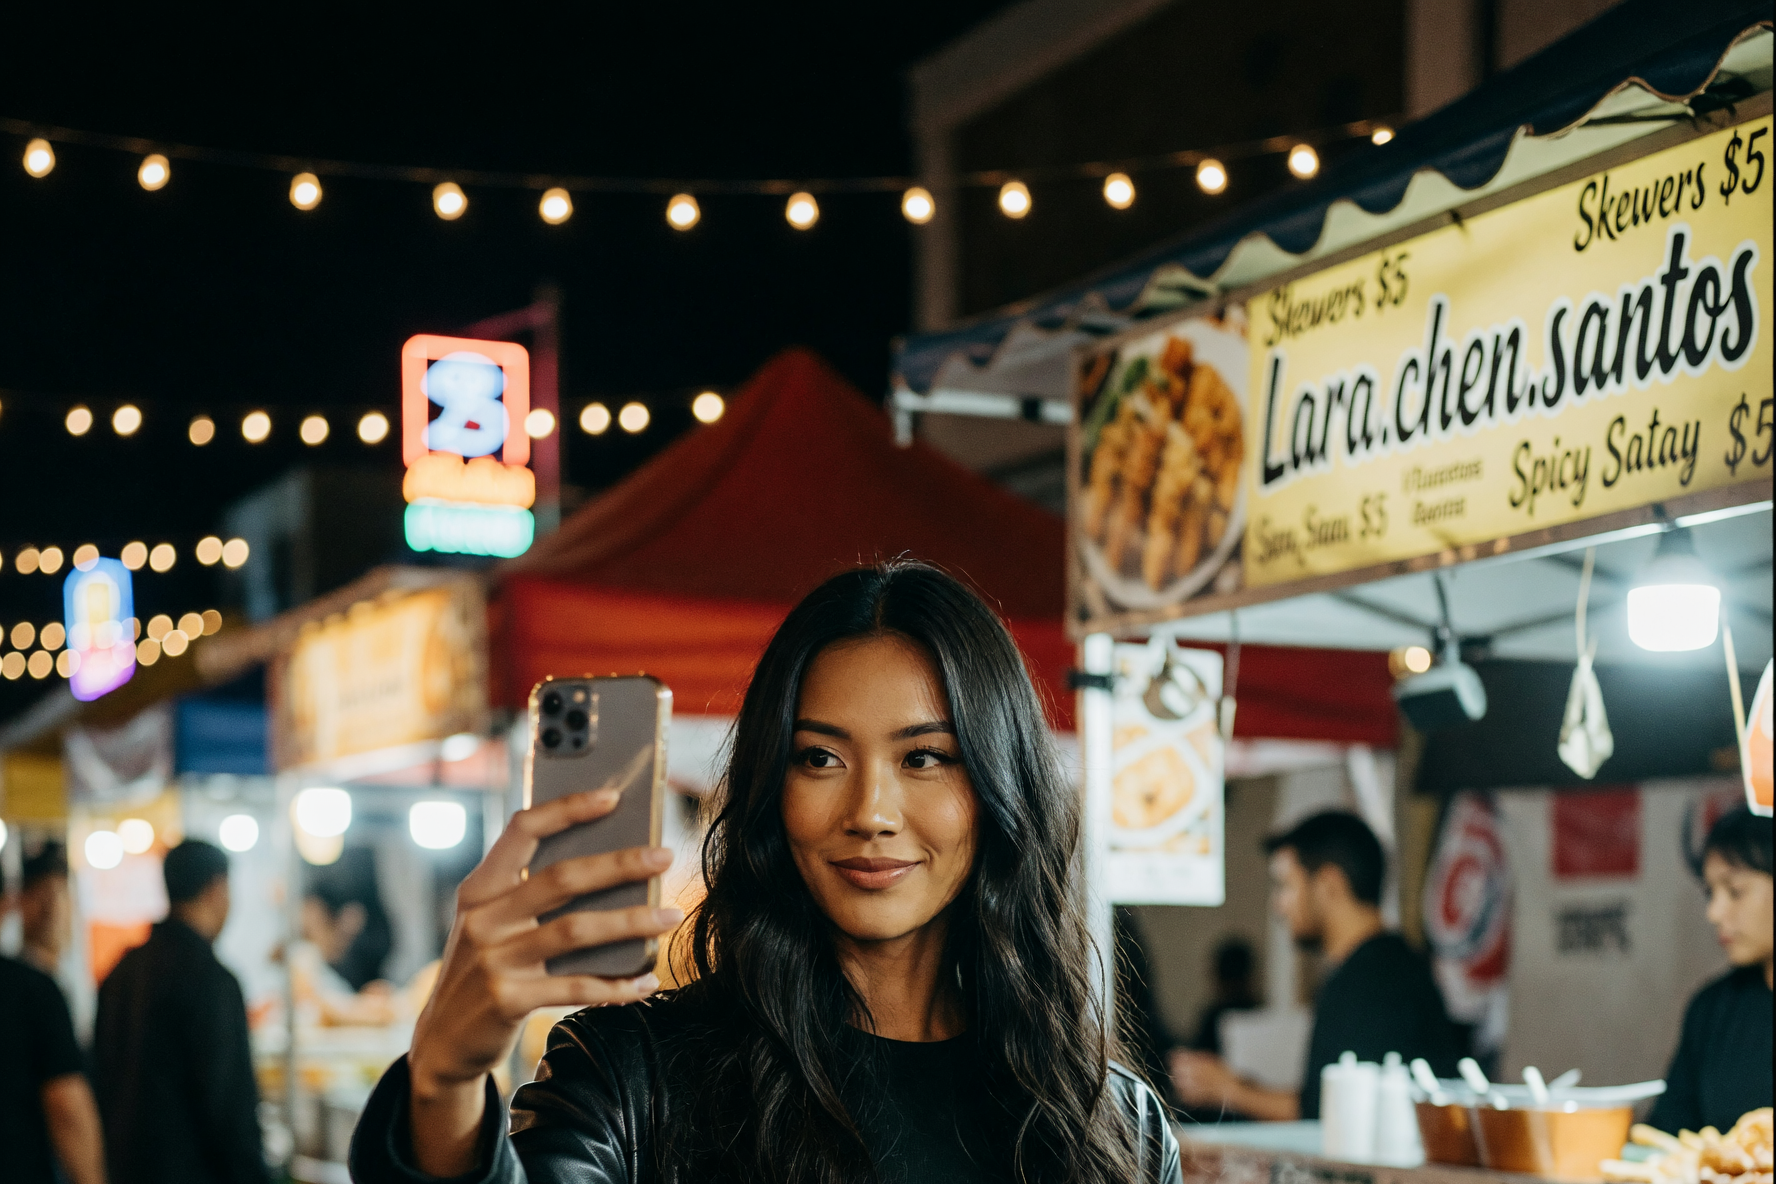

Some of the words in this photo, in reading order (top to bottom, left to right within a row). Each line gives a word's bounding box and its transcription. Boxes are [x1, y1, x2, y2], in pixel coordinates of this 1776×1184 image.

[1574, 162, 1706, 252] Skewers
[1720, 127, 1769, 206] $5
[1375, 252, 1410, 311] $5
[1262, 231, 1756, 486] Lara.chen.santos
[1509, 436, 1591, 517] Spicy
[1602, 408, 1700, 488] Satay
[1724, 392, 1774, 477] $5
